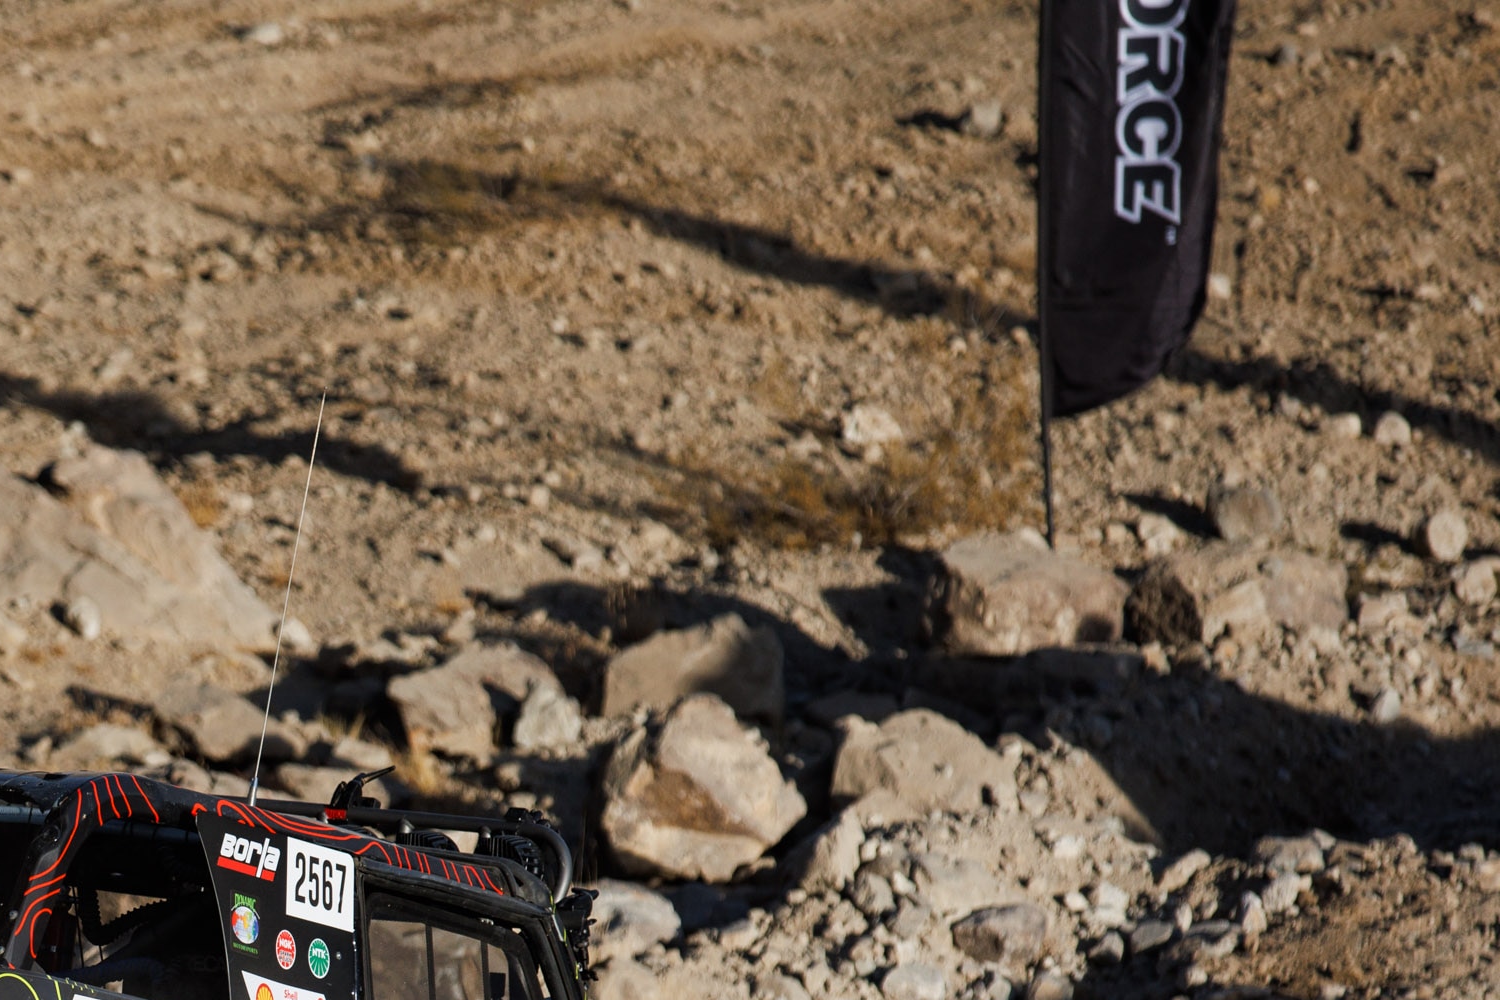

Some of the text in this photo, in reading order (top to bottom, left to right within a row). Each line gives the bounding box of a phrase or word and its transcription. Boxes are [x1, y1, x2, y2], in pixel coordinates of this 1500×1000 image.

[294, 851, 347, 914] 2567
[279, 938, 292, 949] NGK
[312, 948, 325, 959] NTK
[284, 990, 298, 1000] Shell
